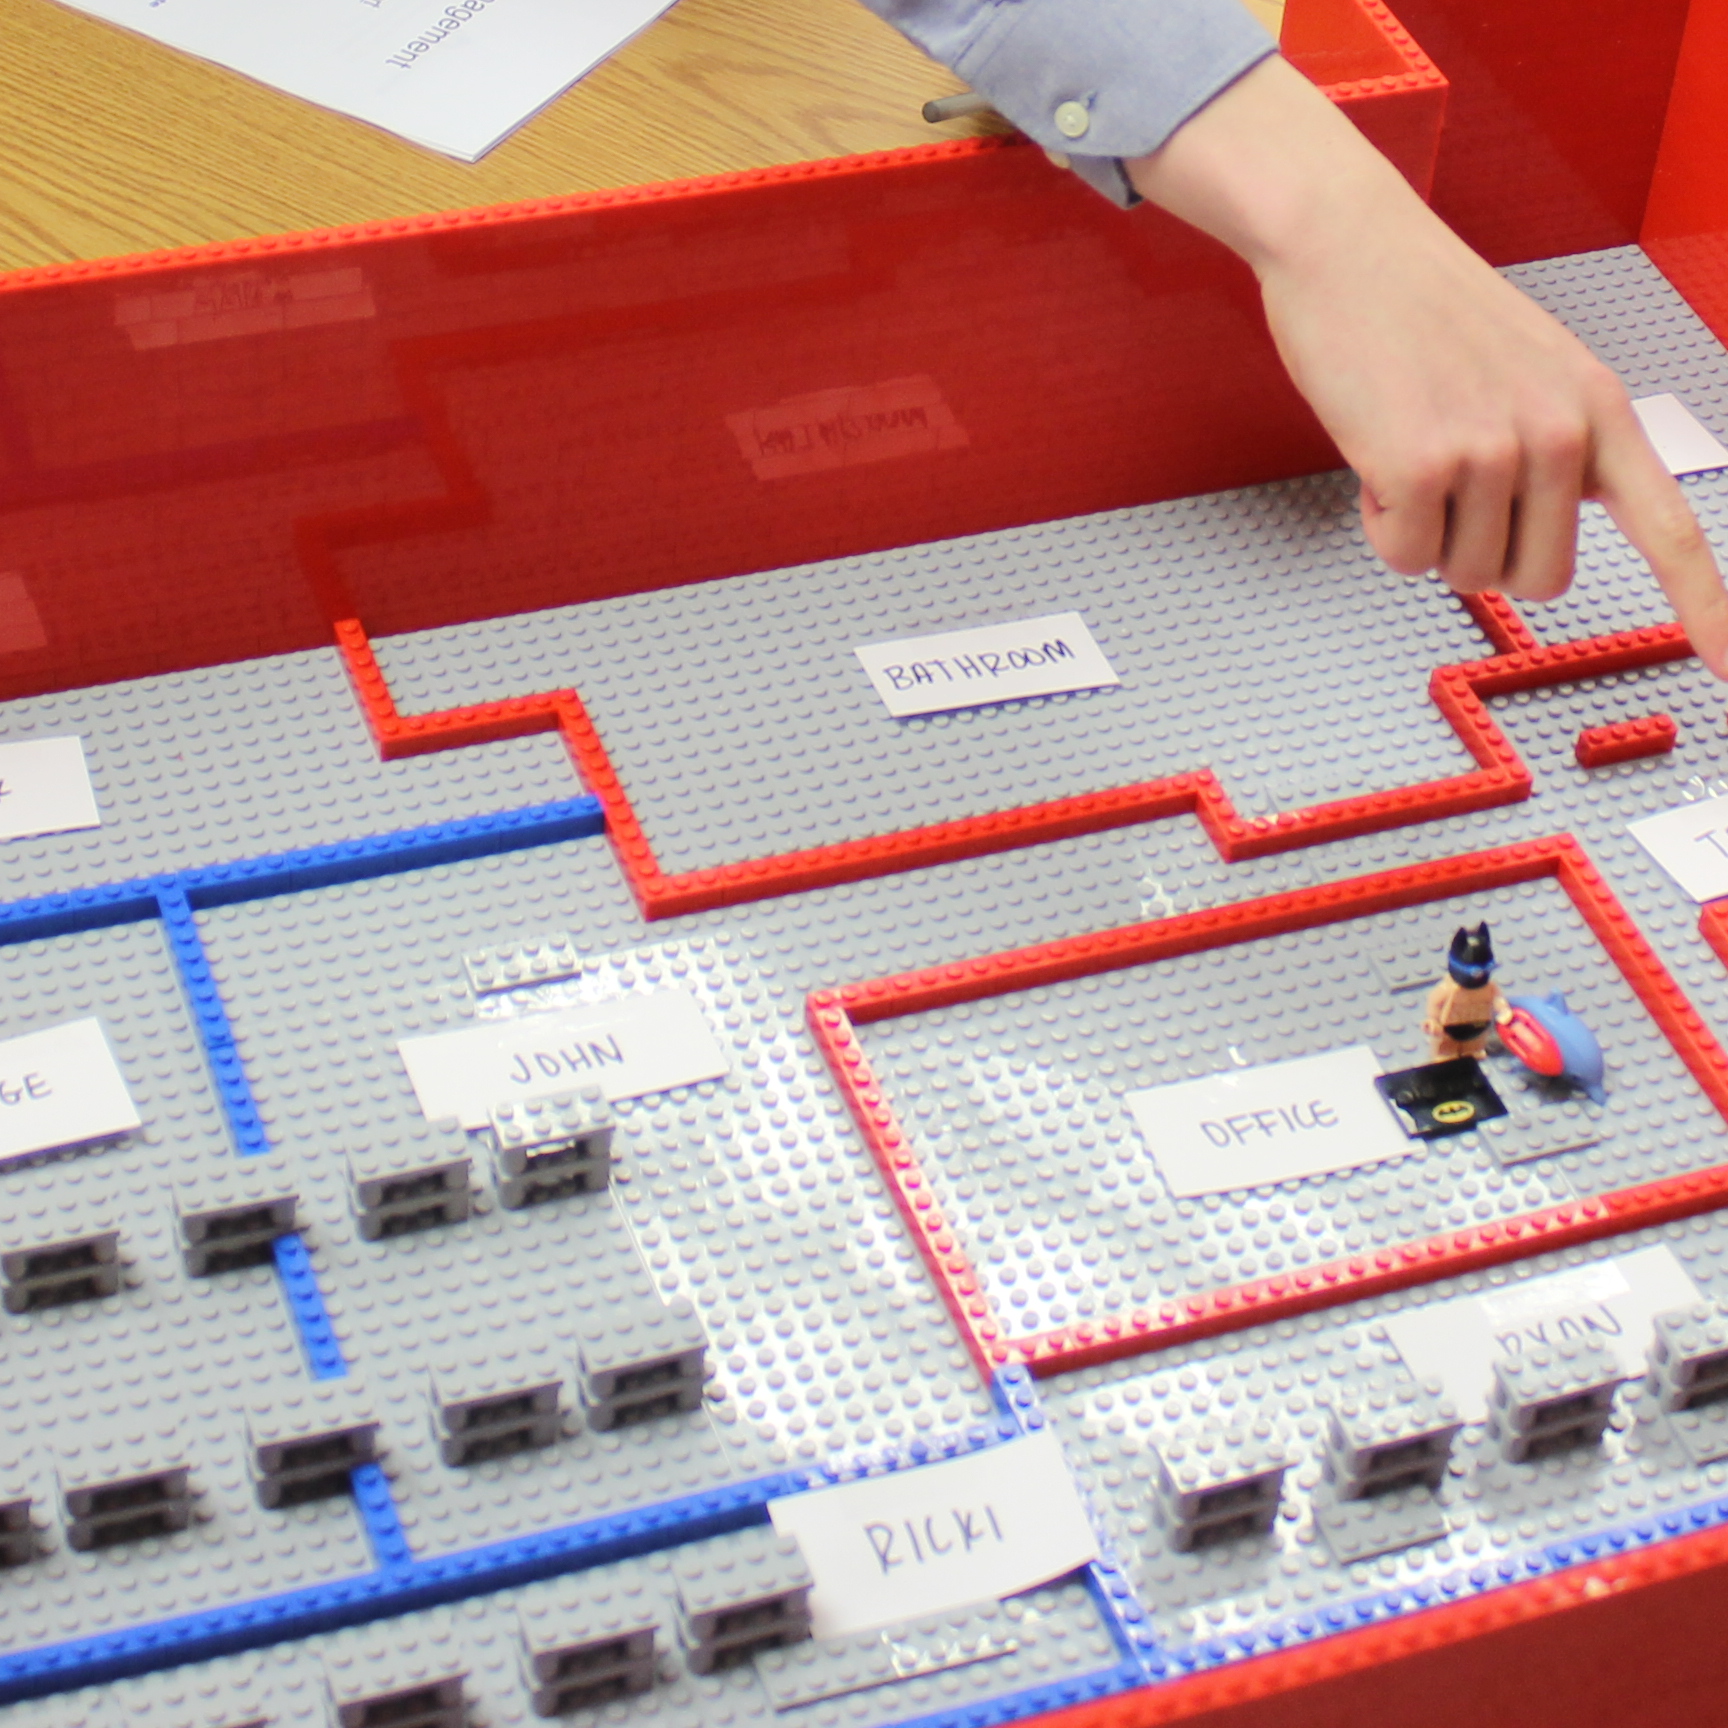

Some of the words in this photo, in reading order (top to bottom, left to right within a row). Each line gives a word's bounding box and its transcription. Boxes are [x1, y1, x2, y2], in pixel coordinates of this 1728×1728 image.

[883, 639, 1075, 690] BATHROOM
[510, 1034, 623, 1083] JOHN
[1200, 1099, 1338, 1148] OFFICE
[864, 1505, 1003, 1575] RICKI
